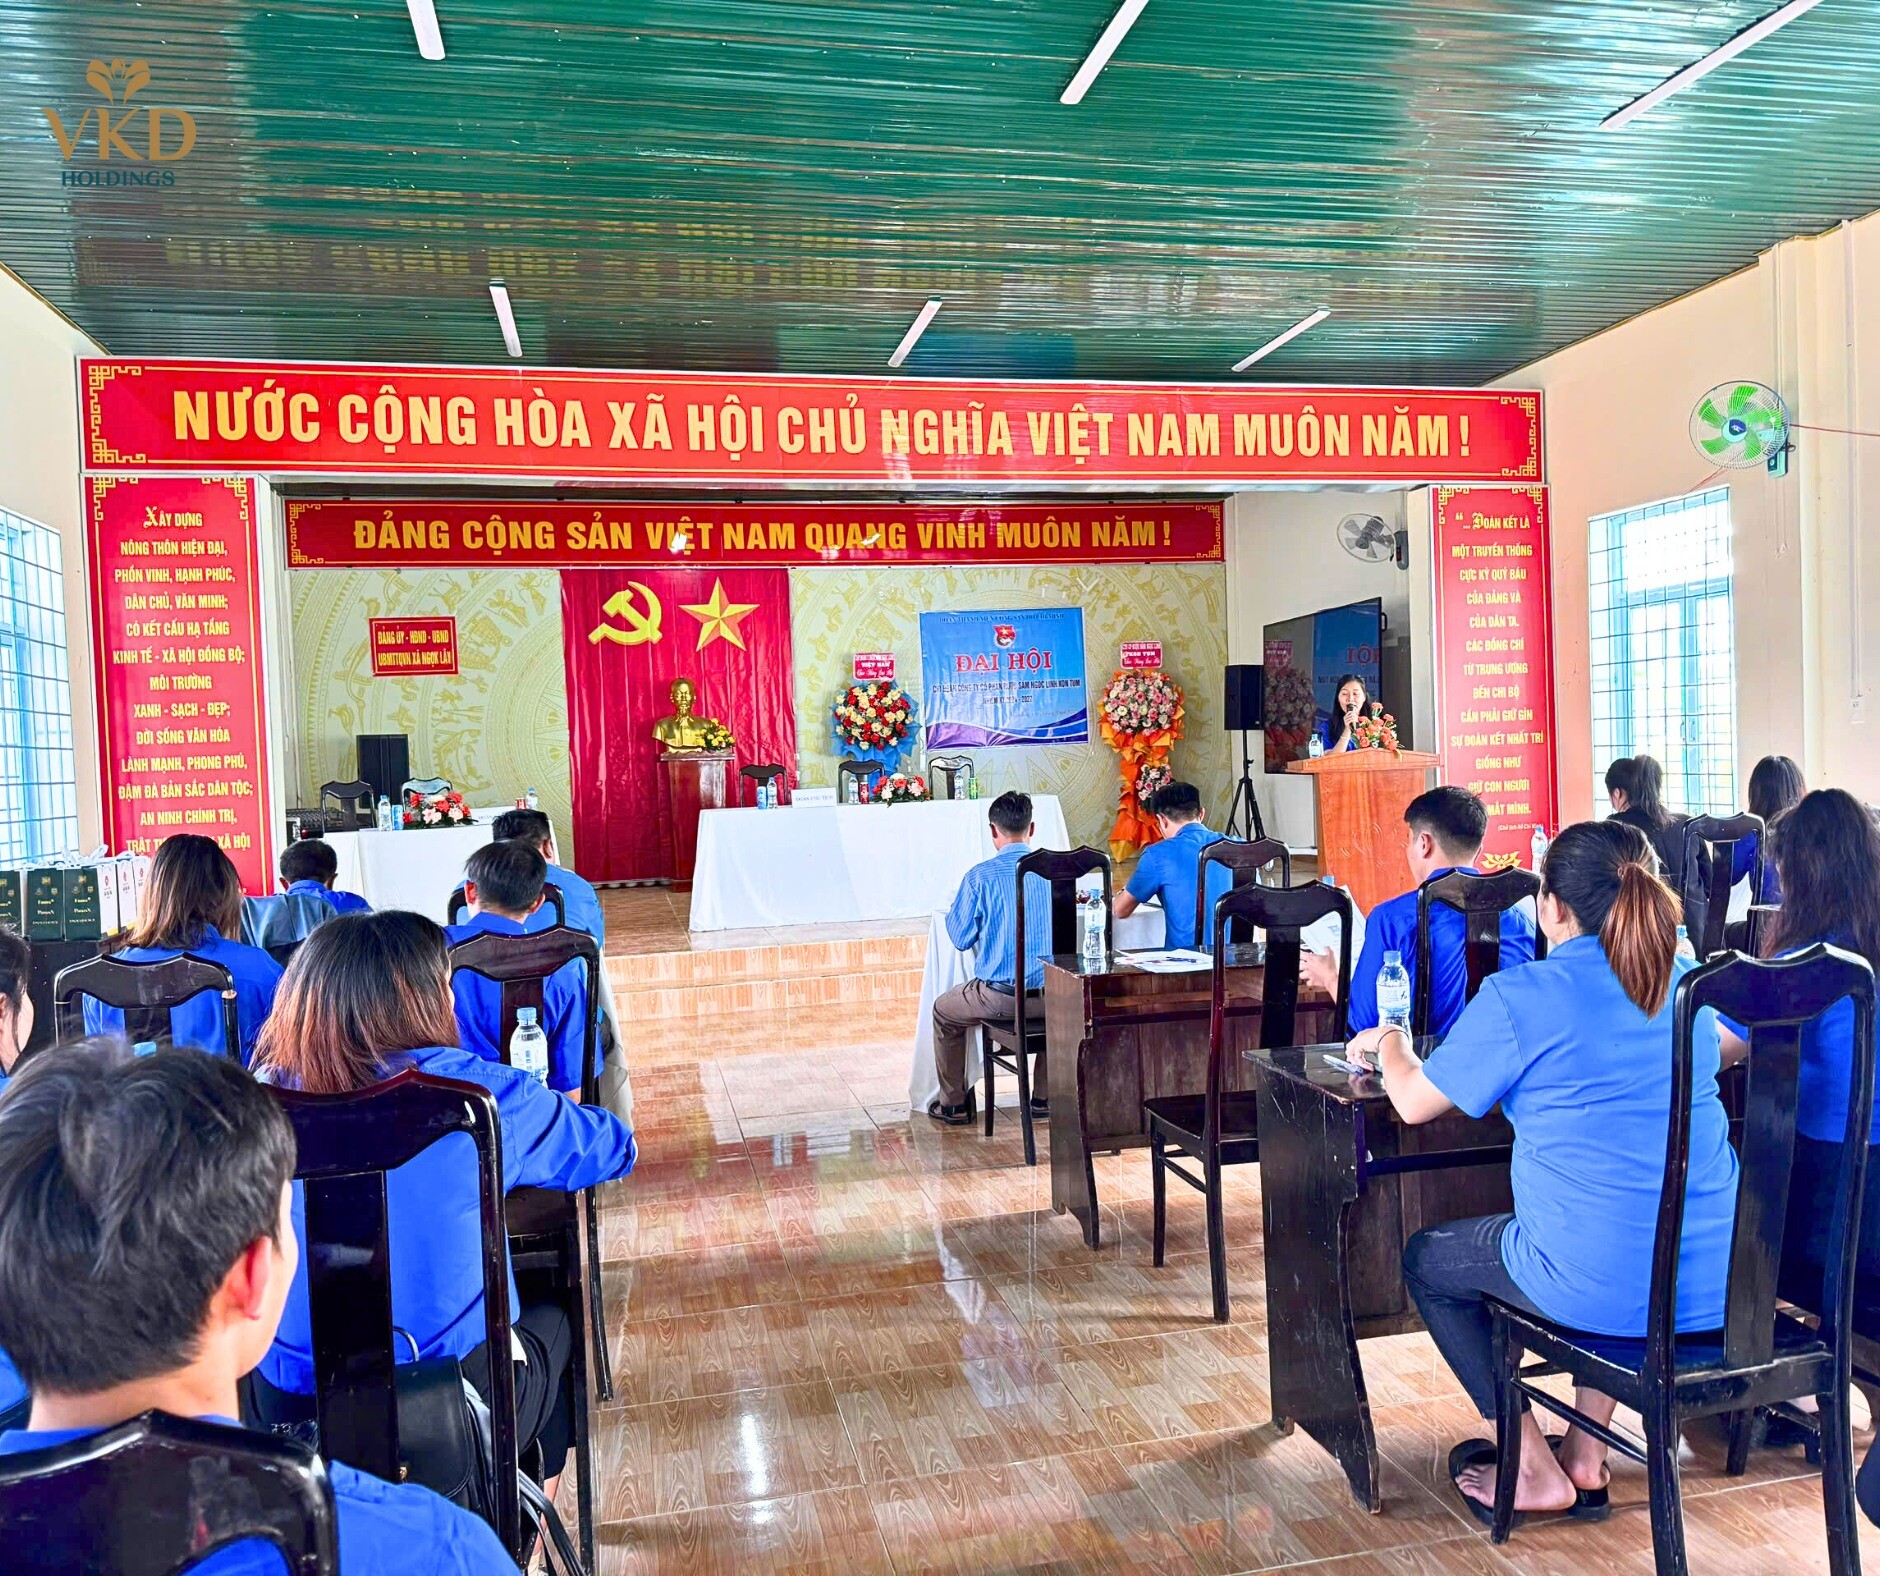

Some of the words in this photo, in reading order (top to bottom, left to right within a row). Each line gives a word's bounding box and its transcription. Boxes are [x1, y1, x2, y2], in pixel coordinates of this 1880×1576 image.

[173, 378, 320, 443] NƯỚC
[337, 384, 477, 454] CỘNG
[495, 387, 592, 448] HÒA
[607, 392, 673, 450] XÃ
[687, 394, 764, 461] HỘI
[777, 393, 867, 454] CHỦ
[881, 401, 1012, 456] NGHĨA
[1026, 403, 1114, 465] VIỆT
[1127, 413, 1220, 457] NAM
[1234, 405, 1360, 457] MUÔN
[1362, 405, 1450, 457] NĂM
[1459, 415, 1470, 457] !
[143, 506, 172, 529] XÂY
[175, 512, 203, 529] DỰNG
[1503, 514, 1518, 529] KẾT
[1519, 516, 1530, 529] LÀ
[354, 509, 450, 549] ĐẢNG
[462, 514, 555, 555] CỘNG
[567, 511, 632, 550] SẢN
[648, 516, 714, 556] VIỆT
[722, 522, 796, 551] NAM
[804, 522, 907, 551] QUANG
[918, 521, 986, 550] VINH
[996, 516, 1081, 549] MUÔN
[1091, 516, 1156, 548] NĂM
[1164, 520, 1171, 547] !
[120, 540, 149, 556] NÔNG
[152, 540, 178, 556] THÔN
[181, 539, 204, 557] HIỆN
[207, 541, 228, 557] ĐẠI,
[1452, 544, 1470, 560] MỘT
[1472, 542, 1504, 557] TRUYỀN
[1506, 541, 1532, 557] THỐNG
[115, 565, 143, 583] PHỒN
[145, 569, 173, 584] VINH,
[175, 568, 203, 584] HẠNH
[205, 565, 235, 582] PHÚC,
[1460, 569, 1476, 582] CỰC
[1510, 567, 1526, 580] BÁU
[125, 593, 146, 609] DÂN
[149, 591, 173, 610] CHỦ,
[175, 593, 196, 609] VĂN
[198, 595, 228, 609] MINH;
[1467, 592, 1483, 605] CỦA
[1486, 591, 1508, 604] ĐẢNG
[1510, 590, 1521, 603] VÀ
[126, 621, 140, 636] CÓ
[143, 618, 161, 635] KẾT
[164, 618, 185, 635] CẤU
[187, 622, 200, 638] HẠ
[203, 618, 229, 635] TẦNG
[1469, 615, 1486, 628] CỦA
[1488, 615, 1506, 628] DÂN
[1466, 638, 1483, 652] CÁC
[1485, 636, 1508, 651] ĐỒNG
[1510, 636, 1524, 650] CHÍ
[113, 650, 138, 664] KINH
[141, 646, 152, 663] TẾ
[162, 647, 176, 663] XÃ
[178, 647, 195, 665] HỘI
[198, 645, 225, 662] ĐỒNG
[955, 653, 999, 676] ĐẠI
[1008, 647, 1052, 675] HỘI
[1476, 663, 1503, 675] TRUNG
[150, 676, 169, 690] MÔI
[172, 673, 211, 690] TRƯỜNG
[1473, 684, 1490, 699] ĐẾN
[1492, 686, 1506, 698] CHI
[1508, 684, 1520, 701] BỘ
[134, 704, 161, 718] XANH
[171, 703, 198, 720] SẠCH
[1461, 707, 1478, 723] CẦN
[1480, 709, 1500, 722] PHẢI
[1518, 708, 1533, 721] GÌN
[136, 728, 154, 744] ĐỜI
[157, 725, 184, 744] SỐNG
[186, 727, 207, 743] VĂN
[210, 727, 230, 742] HÓA
[1490, 731, 1505, 745] KẾT
[1507, 731, 1528, 744] NHẤT
[1530, 730, 1543, 744] TRÍ
[121, 756, 148, 772] LÀNH
[151, 757, 185, 774] MẠNH,
[187, 756, 221, 771] PHONG
[224, 752, 247, 770] PHÚ,
[1475, 755, 1501, 770] GIỐNG
[1503, 756, 1522, 768] NHƯ
[118, 782, 142, 802] ĐẬM
[144, 782, 158, 798] ĐÀ
[161, 780, 182, 798] BẢN
[185, 778, 204, 797] SẮC
[208, 779, 228, 796] DÂN
[1484, 781, 1502, 793] CON
[140, 812, 154, 826] AN
[158, 810, 182, 824] NINH
[185, 808, 216, 823] CHÍNH
[126, 836, 152, 855] TRẬT
[234, 832, 251, 851] HỘI
